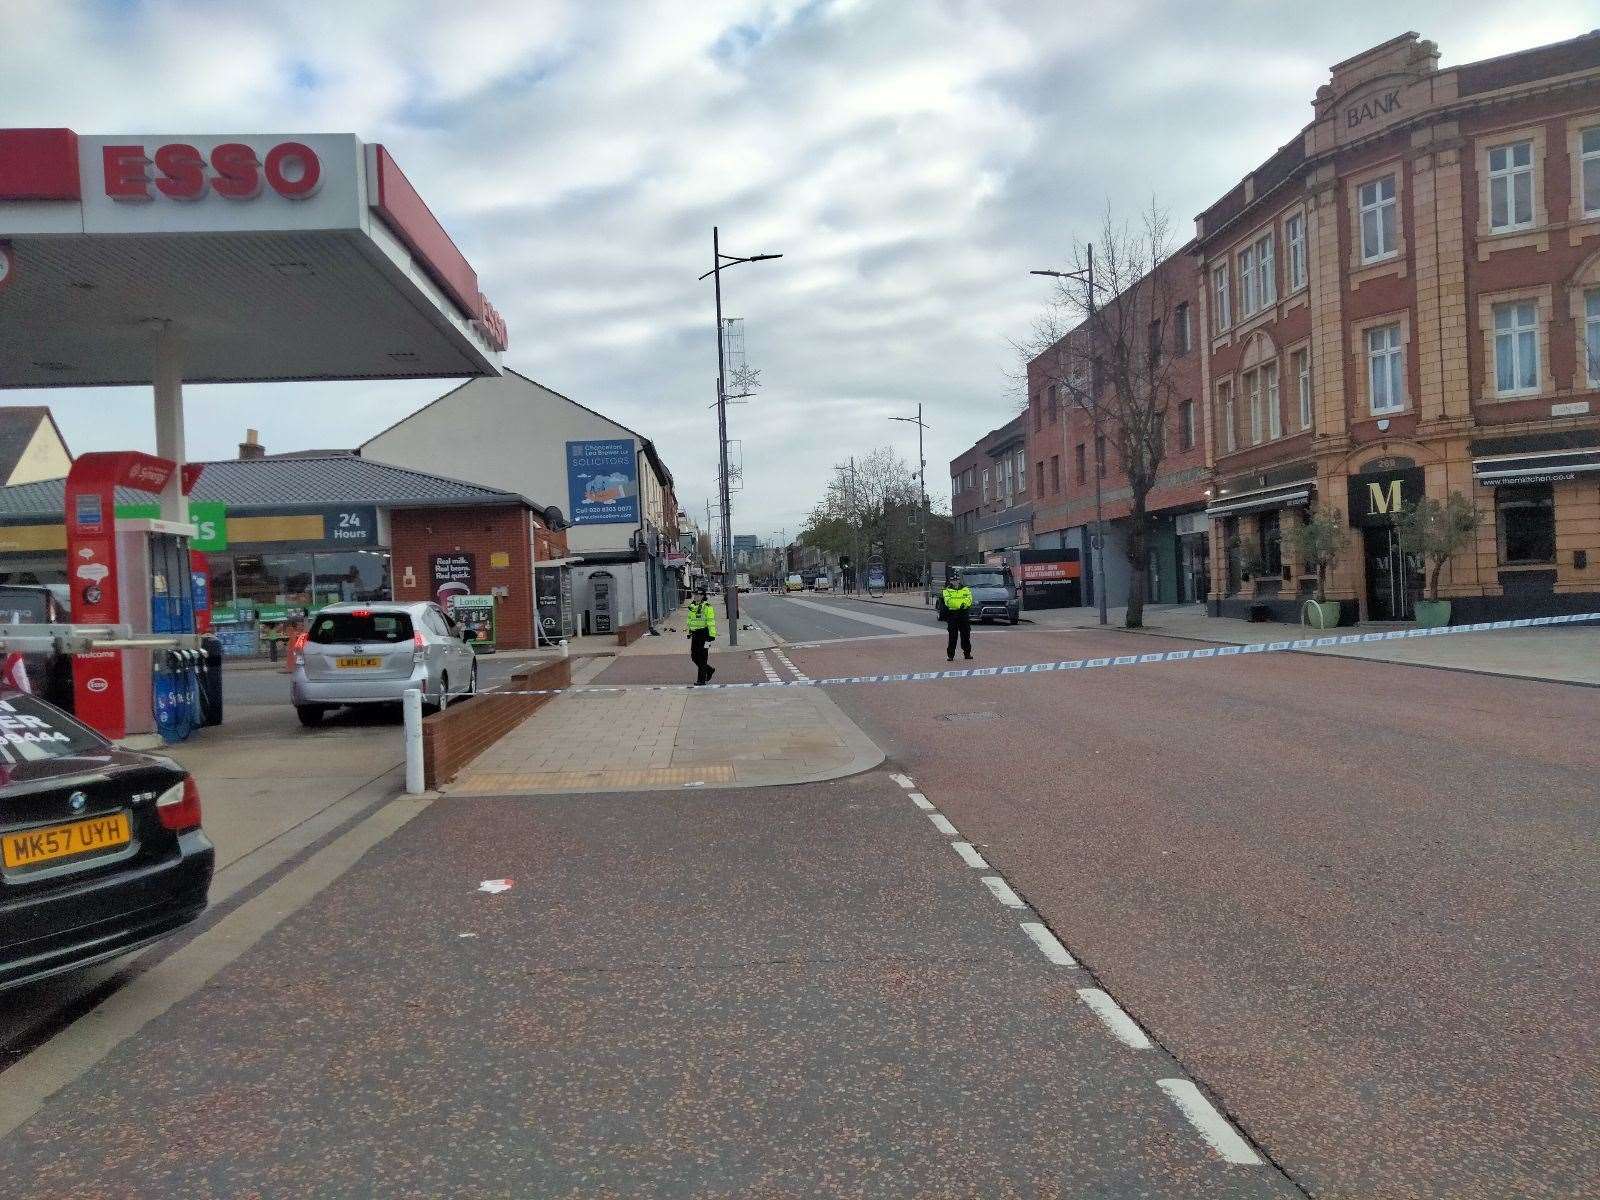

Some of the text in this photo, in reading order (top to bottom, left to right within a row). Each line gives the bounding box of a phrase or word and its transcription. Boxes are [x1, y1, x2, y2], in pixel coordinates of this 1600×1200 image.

[1347, 89, 1401, 128] BANK
[102, 142, 323, 201] ESSO
[572, 456, 631, 467] SOLICITORS
[1366, 479, 1405, 515] M
[339, 513, 361, 528] 24
[333, 529, 367, 540] Hours
[436, 557, 451, 565] Real
[459, 597, 489, 606] Londis
[13, 818, 121, 861] MK57 UYH
